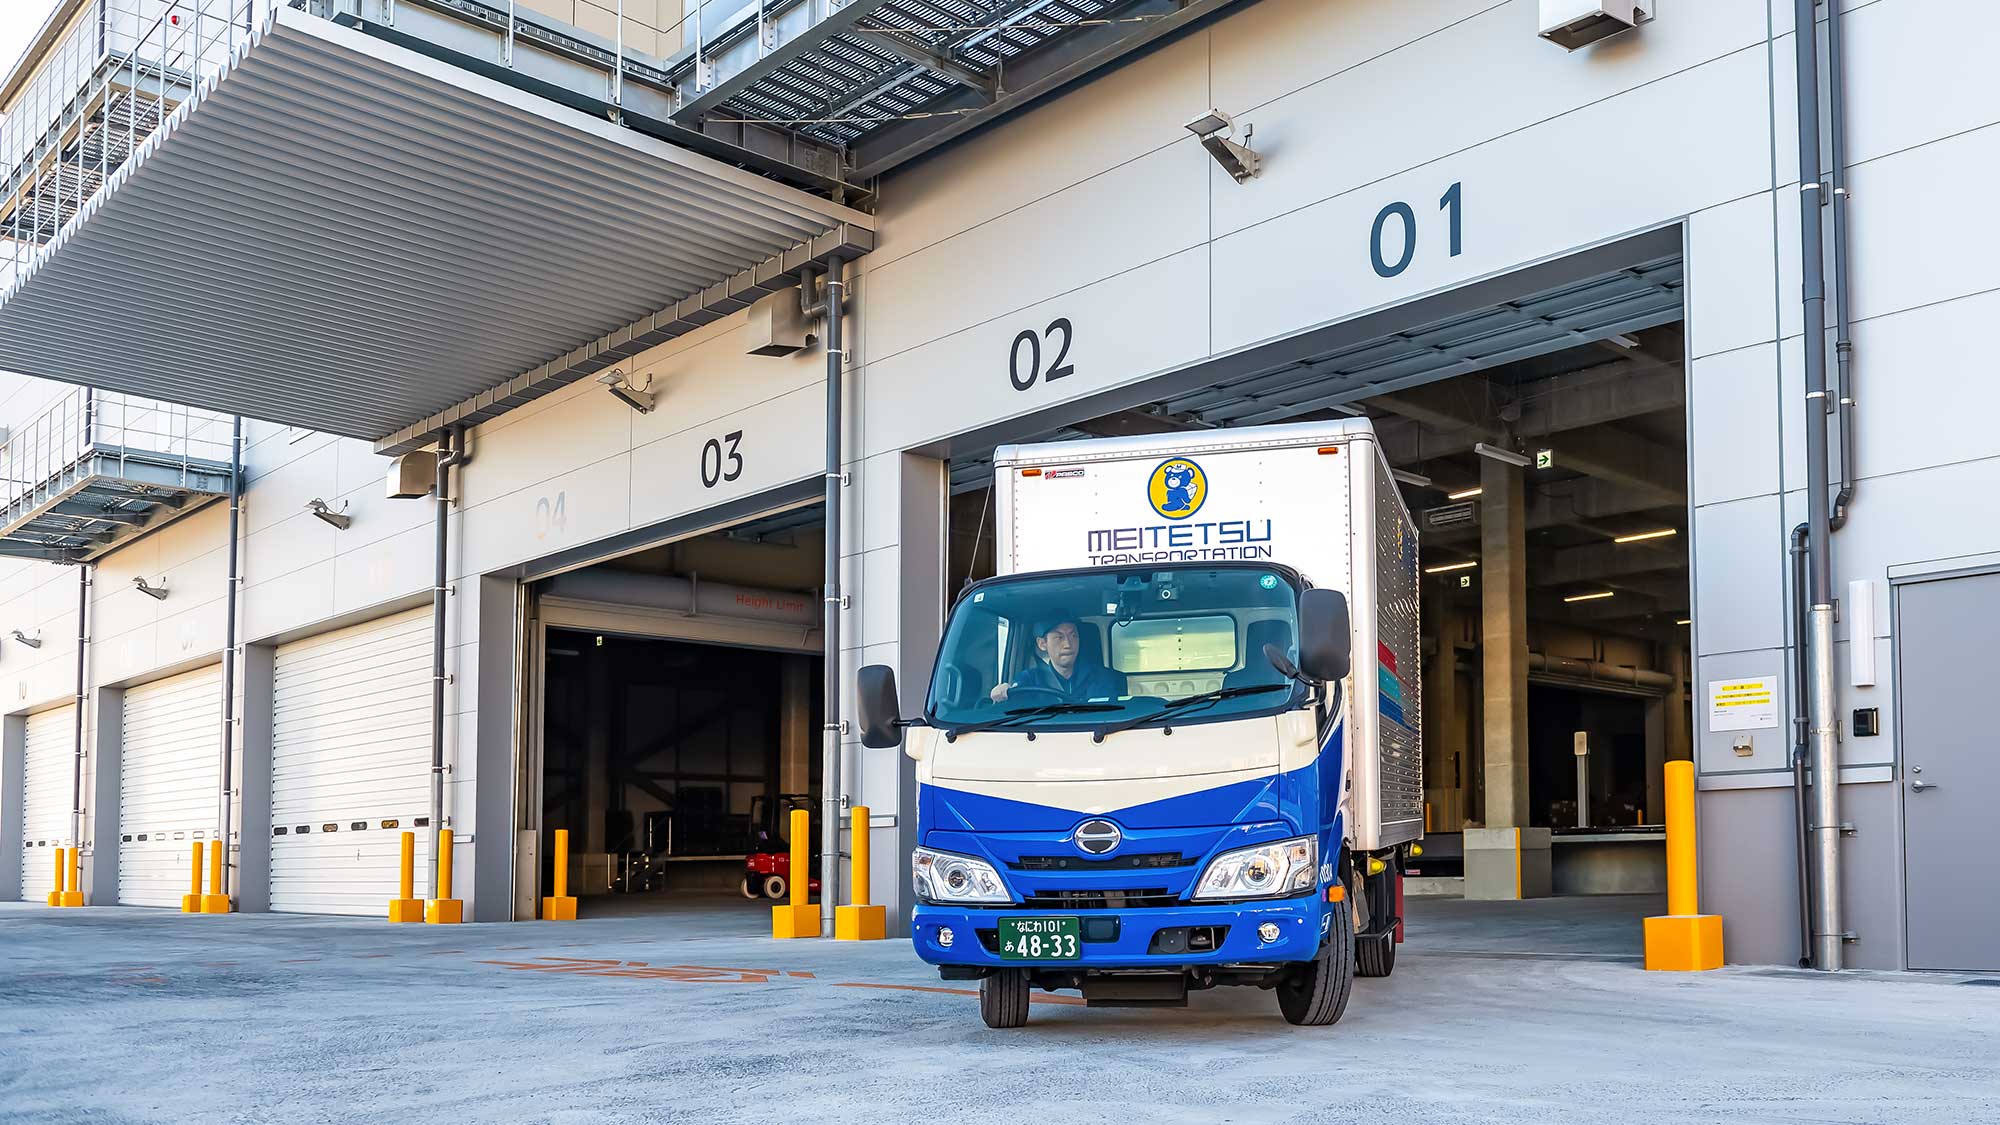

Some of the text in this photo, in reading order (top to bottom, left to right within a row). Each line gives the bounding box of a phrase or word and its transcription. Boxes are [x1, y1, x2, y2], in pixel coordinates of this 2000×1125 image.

[1370, 181, 1461, 278] 01
[1010, 318, 1074, 391] 02
[701, 430, 743, 488] 03
[536, 491, 567, 540] 04
[1088, 519, 1271, 552] MEITETSU
[1088, 545, 1271, 565] TRANSPORTATION
[736, 593, 804, 612] Height Limit
[1004, 934, 1076, 957] あ 48-33
